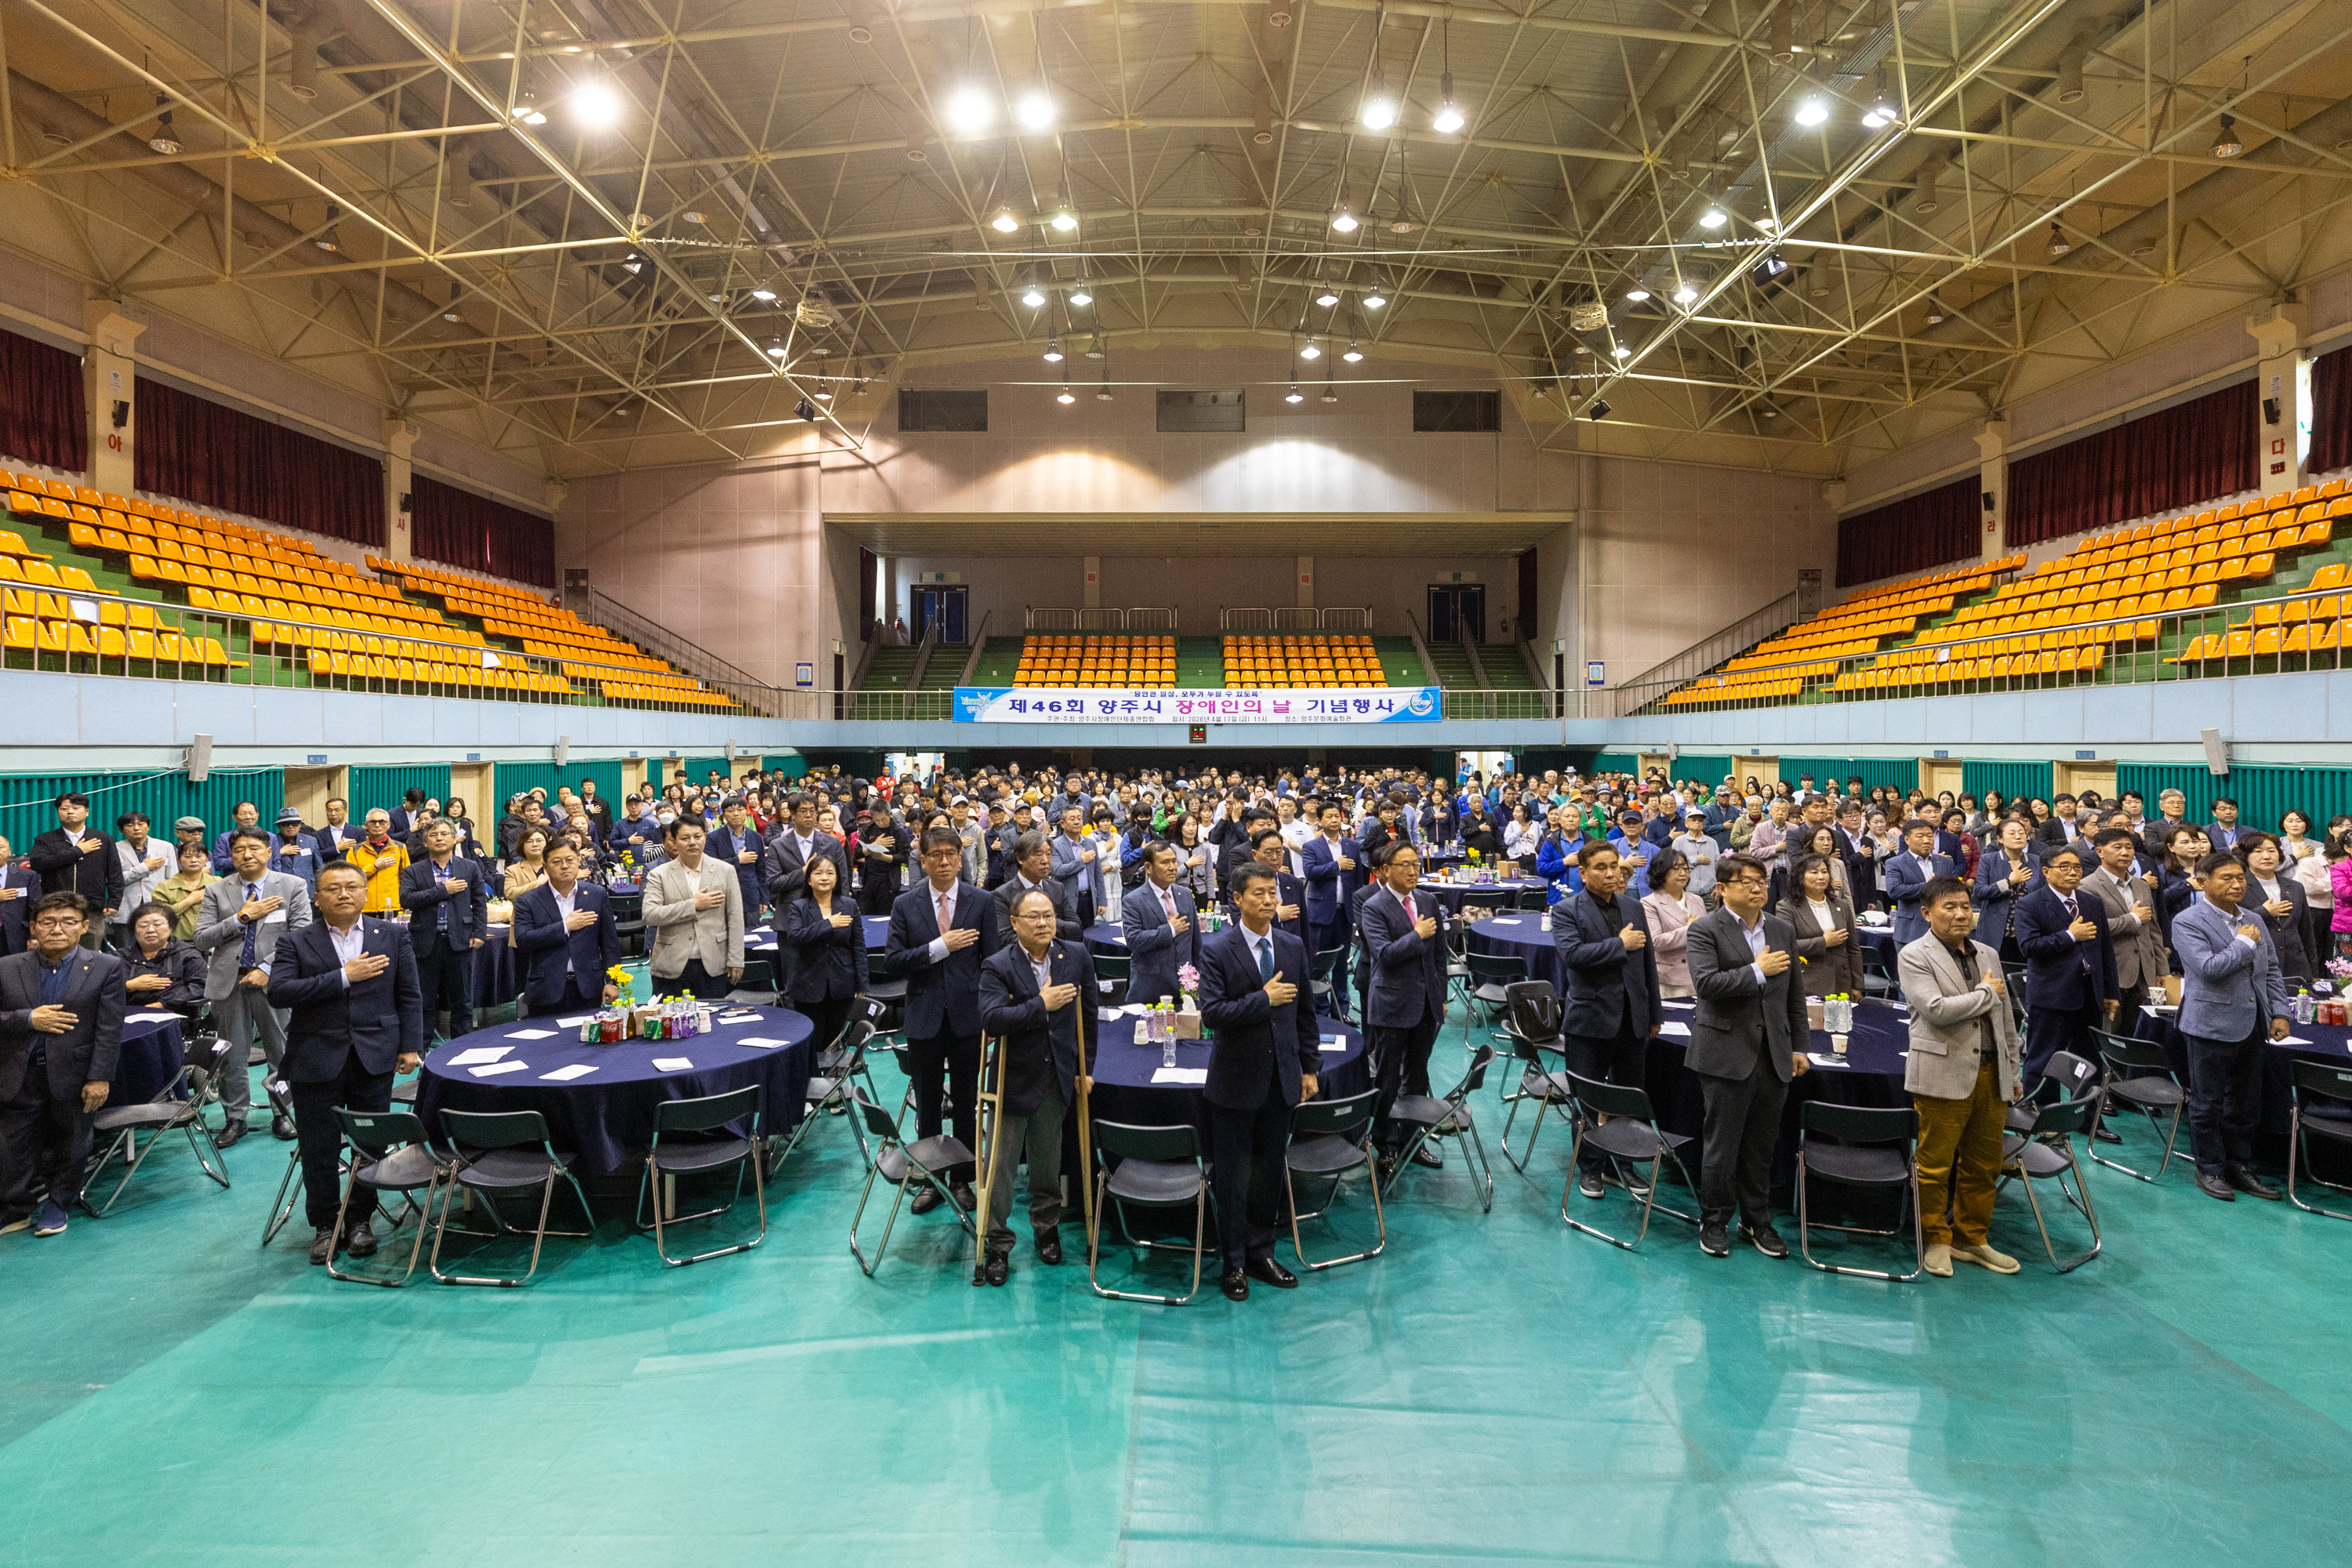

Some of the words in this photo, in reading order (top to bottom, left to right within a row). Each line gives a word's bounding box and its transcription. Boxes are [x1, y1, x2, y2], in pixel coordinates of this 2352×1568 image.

[108, 434, 122, 452] 아
[2271, 438, 2285, 455] 다
[397, 518, 405, 532] 사
[1987, 521, 1995, 532] 라
[1009, 699, 1083, 713] 제46회
[1098, 700, 1162, 714] 양주시
[1176, 700, 1261, 714] 장애인의
[1273, 700, 1292, 713] 날
[1307, 699, 1395, 714] 기념행사
